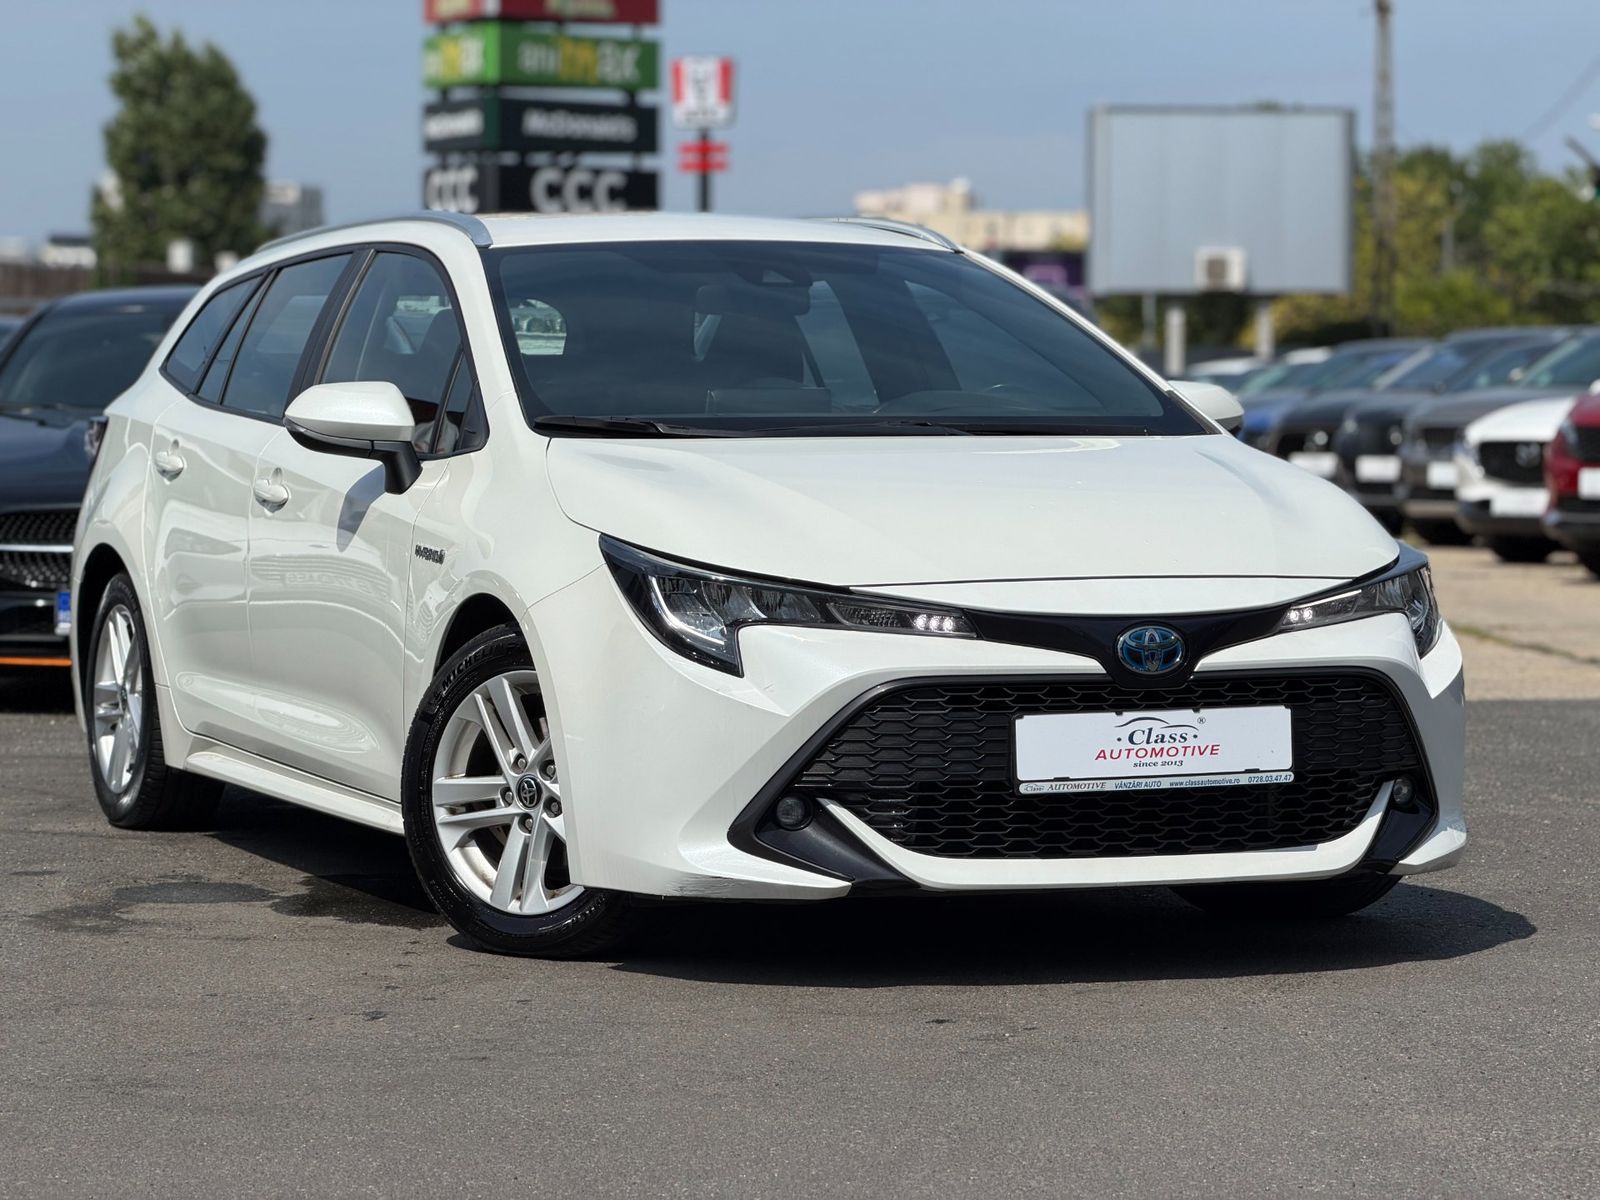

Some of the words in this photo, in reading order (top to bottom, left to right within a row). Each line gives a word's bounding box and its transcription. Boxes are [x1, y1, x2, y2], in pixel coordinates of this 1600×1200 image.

[530, 167, 628, 213] CCC
[1127, 727, 1188, 746] Class
[1095, 744, 1221, 761] AUTOMOTIVE
[1133, 760, 1159, 768] since
[1160, 760, 1184, 768] 2013
[1047, 782, 1107, 791] AUTOMOTIVE
[1143, 780, 1162, 789] AUTO
[1169, 778, 1241, 787] www.classautomotive.ro
[1247, 774, 1292, 784] 0728.03.47.47
